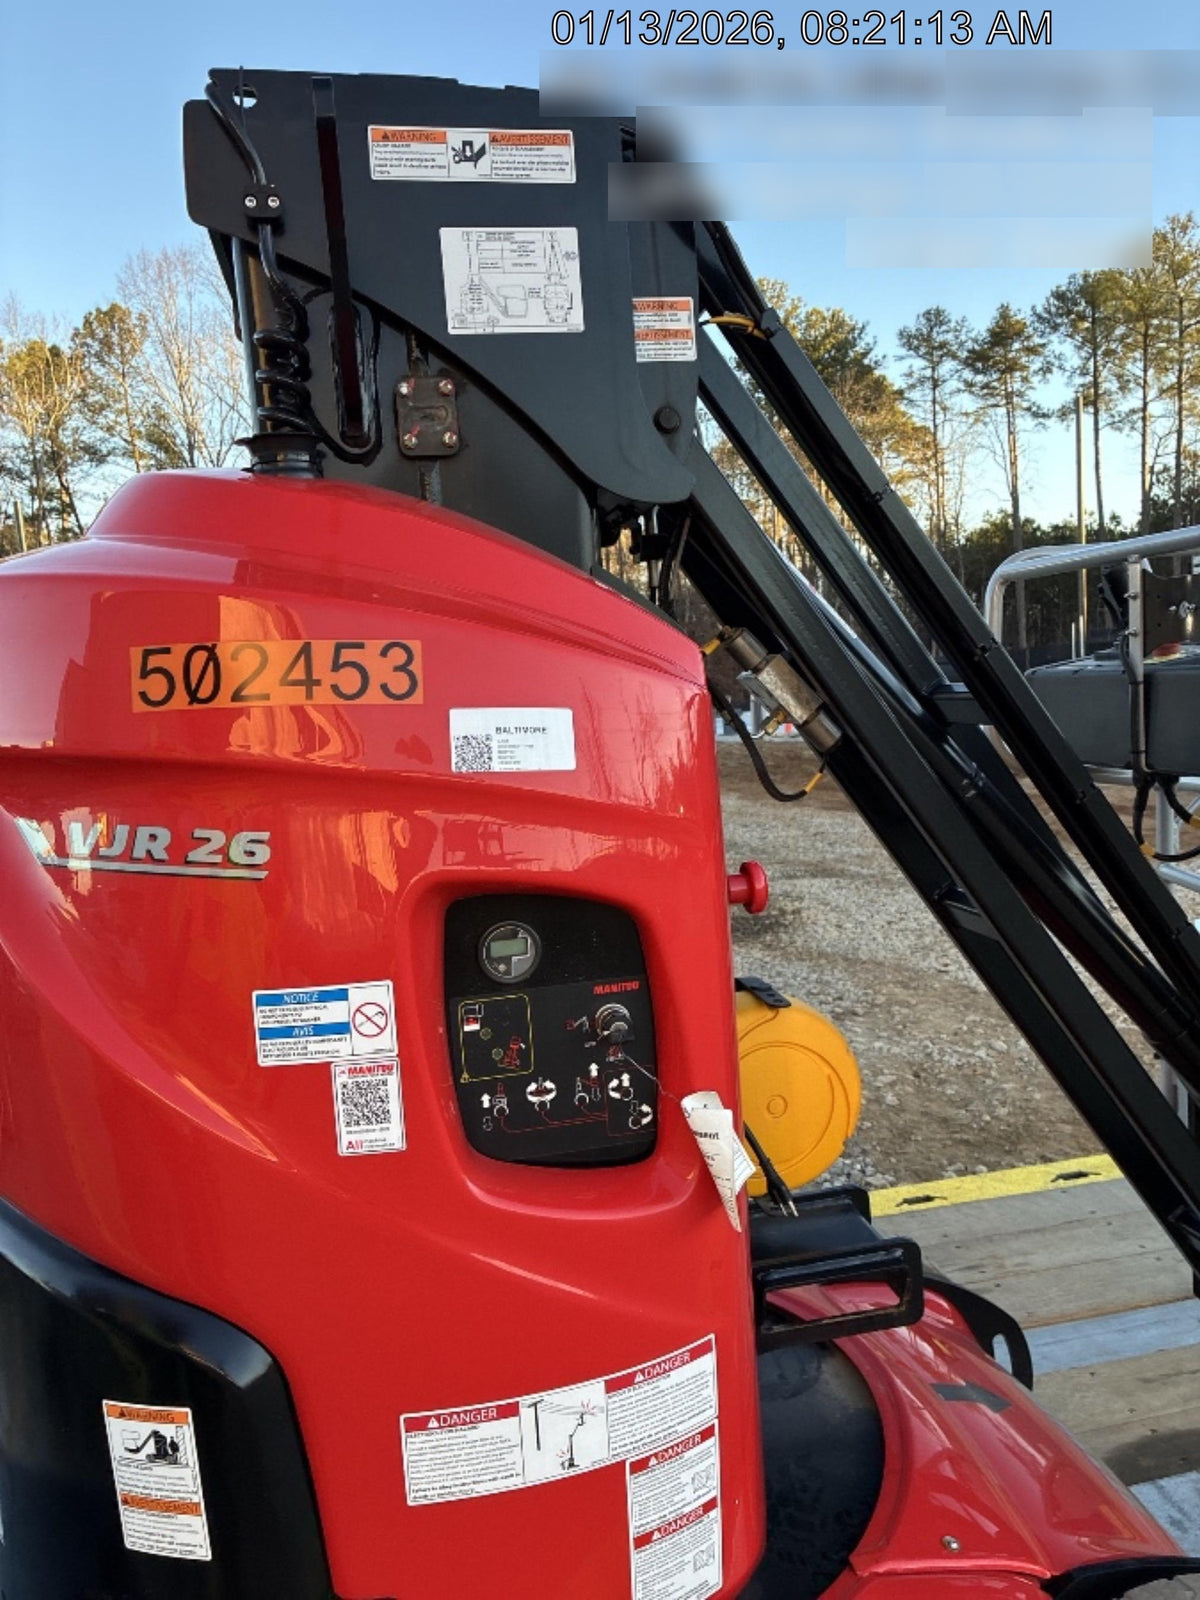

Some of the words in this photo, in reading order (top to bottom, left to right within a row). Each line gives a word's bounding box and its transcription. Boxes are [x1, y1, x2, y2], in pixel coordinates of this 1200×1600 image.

[390, 130, 437, 141] WARNING
[138, 641, 419, 708] 502453
[495, 726, 548, 735] BALTIMORE
[68, 821, 171, 862] VJR
[185, 828, 271, 865] 26
[283, 991, 320, 1004] NOTICE
[592, 980, 640, 995] MANITOU
[292, 1025, 314, 1037] AVIS
[644, 1352, 691, 1379] DANGER
[440, 1407, 498, 1427] DANGER
[658, 1434, 702, 1462] DANGER
[660, 1507, 704, 1536] DANGER
